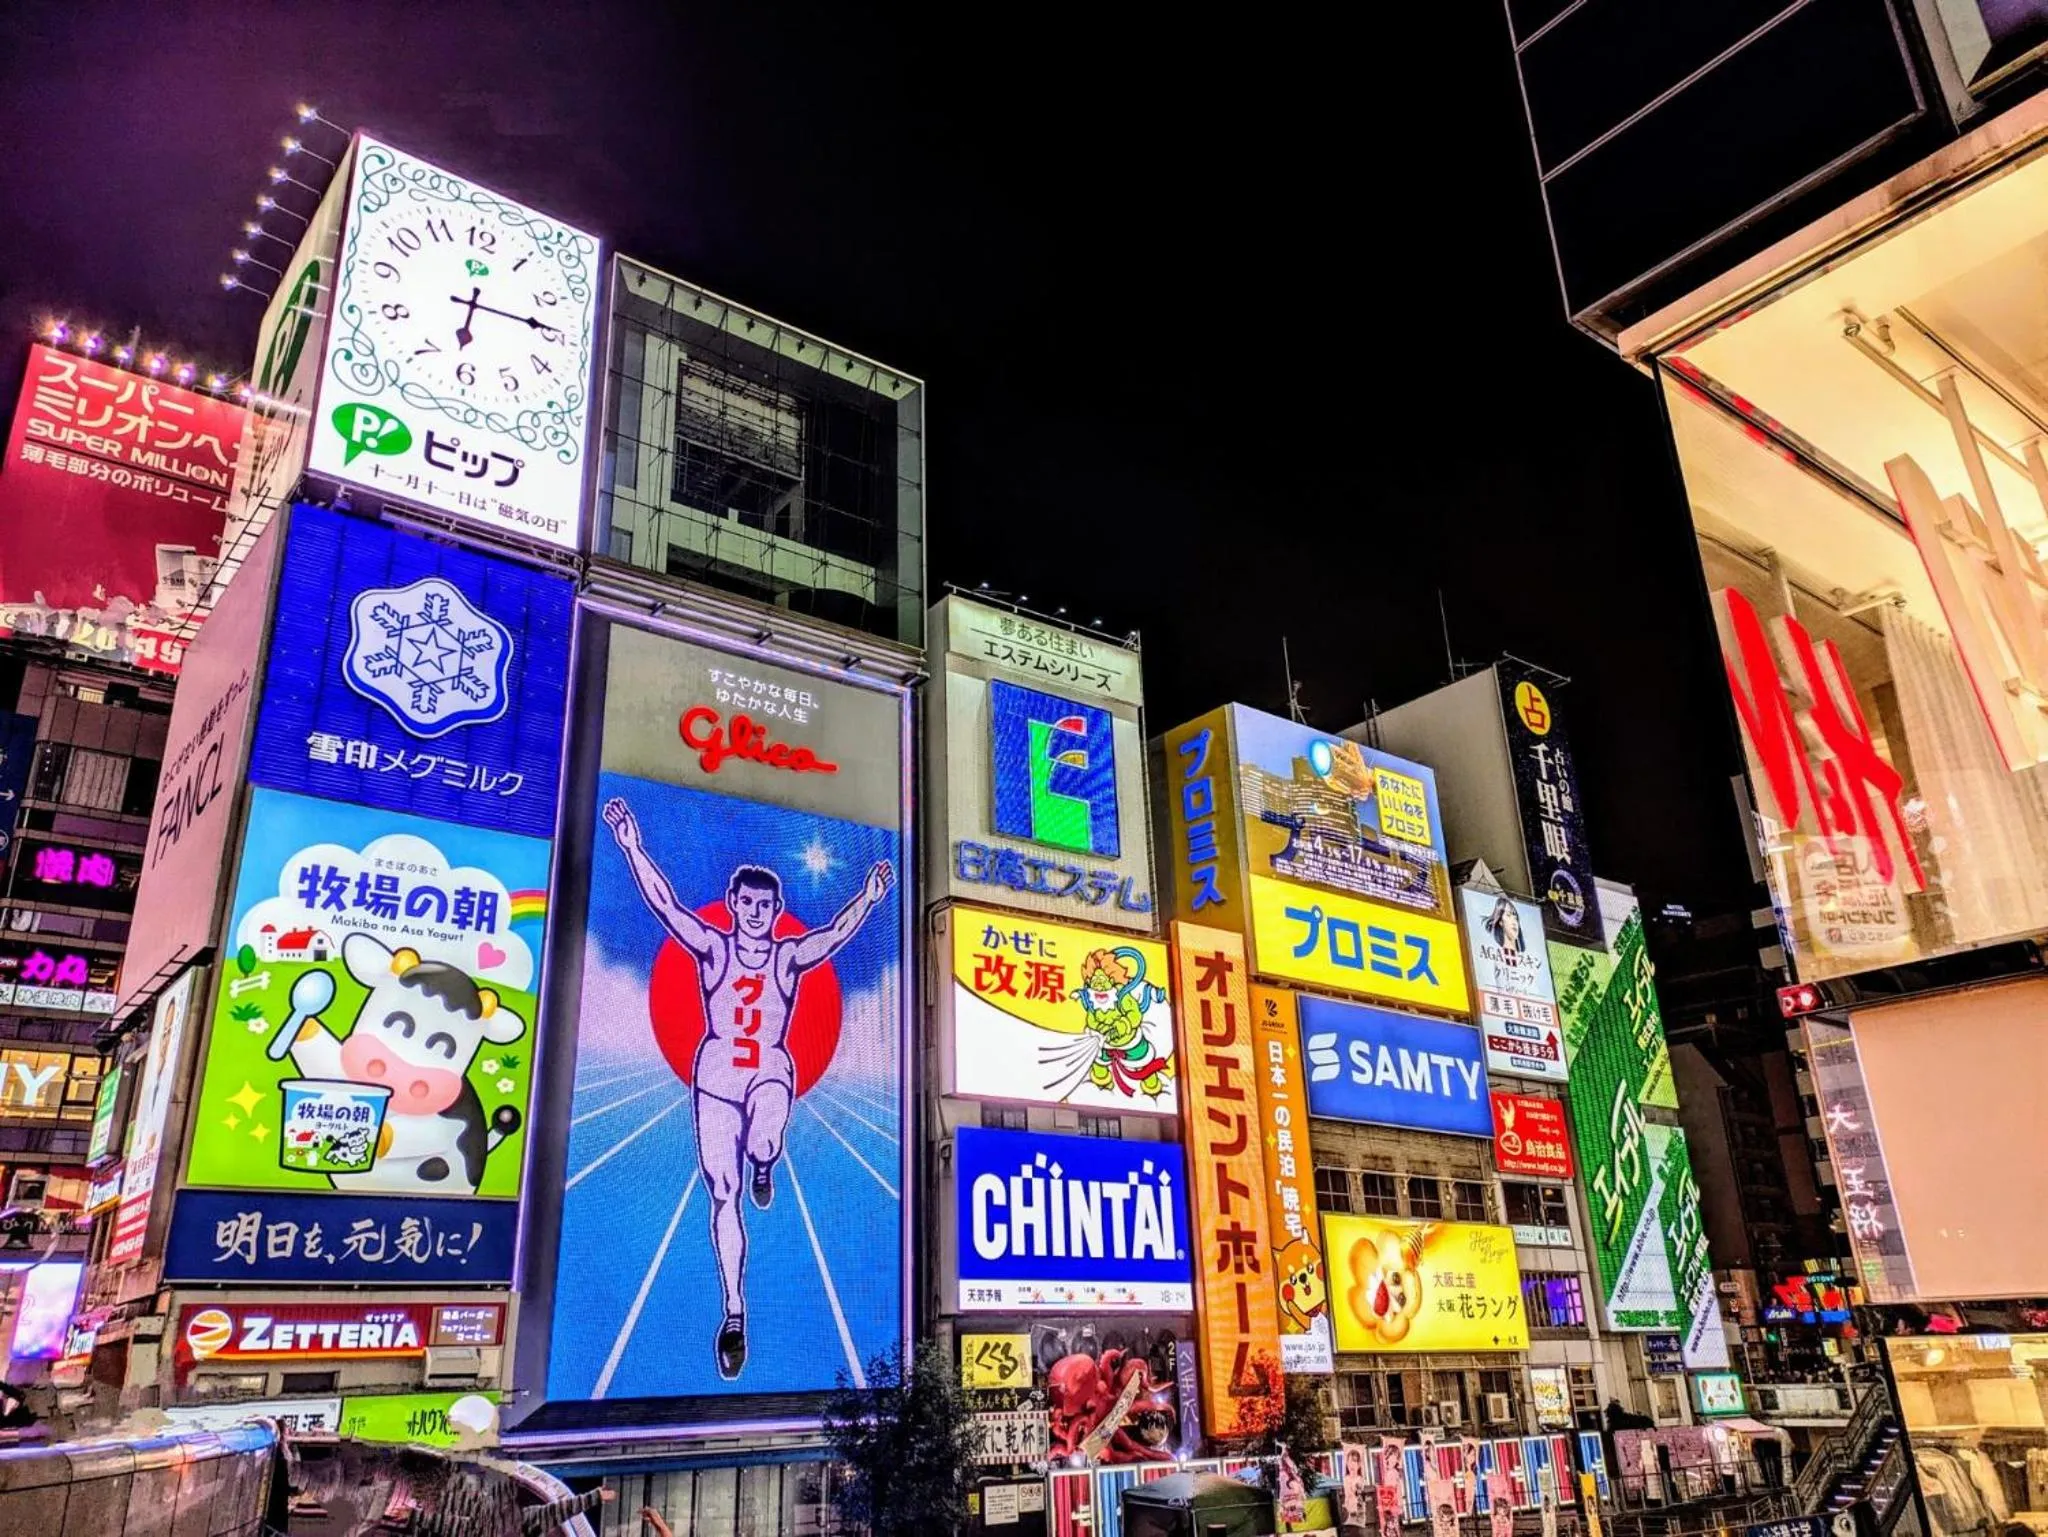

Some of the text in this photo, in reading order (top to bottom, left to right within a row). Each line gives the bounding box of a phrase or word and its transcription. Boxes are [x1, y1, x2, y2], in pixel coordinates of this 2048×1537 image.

[387, 228, 422, 257] 10
[425, 219, 454, 243] 11
[465, 225, 496, 254] 12
[374, 261, 401, 283] 9
[381, 304, 410, 321] 8
[532, 291, 558, 308] 2
[414, 338, 441, 357] 7
[529, 354, 553, 376] 4
[38, 355, 196, 416] スーパー
[456, 362, 476, 385] 6
[498, 367, 519, 392] 5
[26, 417, 229, 488] SUPER MILLION
[423, 430, 525, 487] ピップ
[1000, 617, 1094, 660] 夢ある住まい
[984, 640, 1112, 692] エステムシリーズ
[708, 668, 819, 709] すこやかな毎日、
[716, 688, 808, 724] ゆたかな人生
[1523, 685, 1546, 731] 占
[680, 705, 840, 774] Glico
[306, 731, 524, 796] 雪印メグミルク
[151, 731, 225, 871] FANCL
[1379, 775, 1422, 800] あなたに
[1530, 742, 1571, 865] 千里眼
[1179, 728, 1227, 911] プロミス
[1382, 795, 1425, 820] いいねを
[1386, 816, 1428, 839] プロミス
[298, 863, 499, 935] 牧場の朝
[331, 914, 378, 930] Makiba
[401, 924, 424, 936] Asa
[427, 928, 465, 942] Yogurt
[982, 924, 1058, 959] かぜに
[1284, 904, 1440, 987] プロミス
[973, 953, 1067, 1004] 改源
[1493, 966, 1535, 986] クリニック
[1517, 954, 1544, 972] スキン
[731, 972, 767, 1069] グリコ
[1349, 1039, 1482, 1101] SAMTY
[298, 1102, 371, 1123] 牧場の朝
[1194, 949, 1269, 1398] オリエントホーム
[1432, 1270, 1479, 1291] 大阪土産
[239, 1316, 419, 1351] ZETTERIA
[456, 1333, 491, 1343] コーヒー
